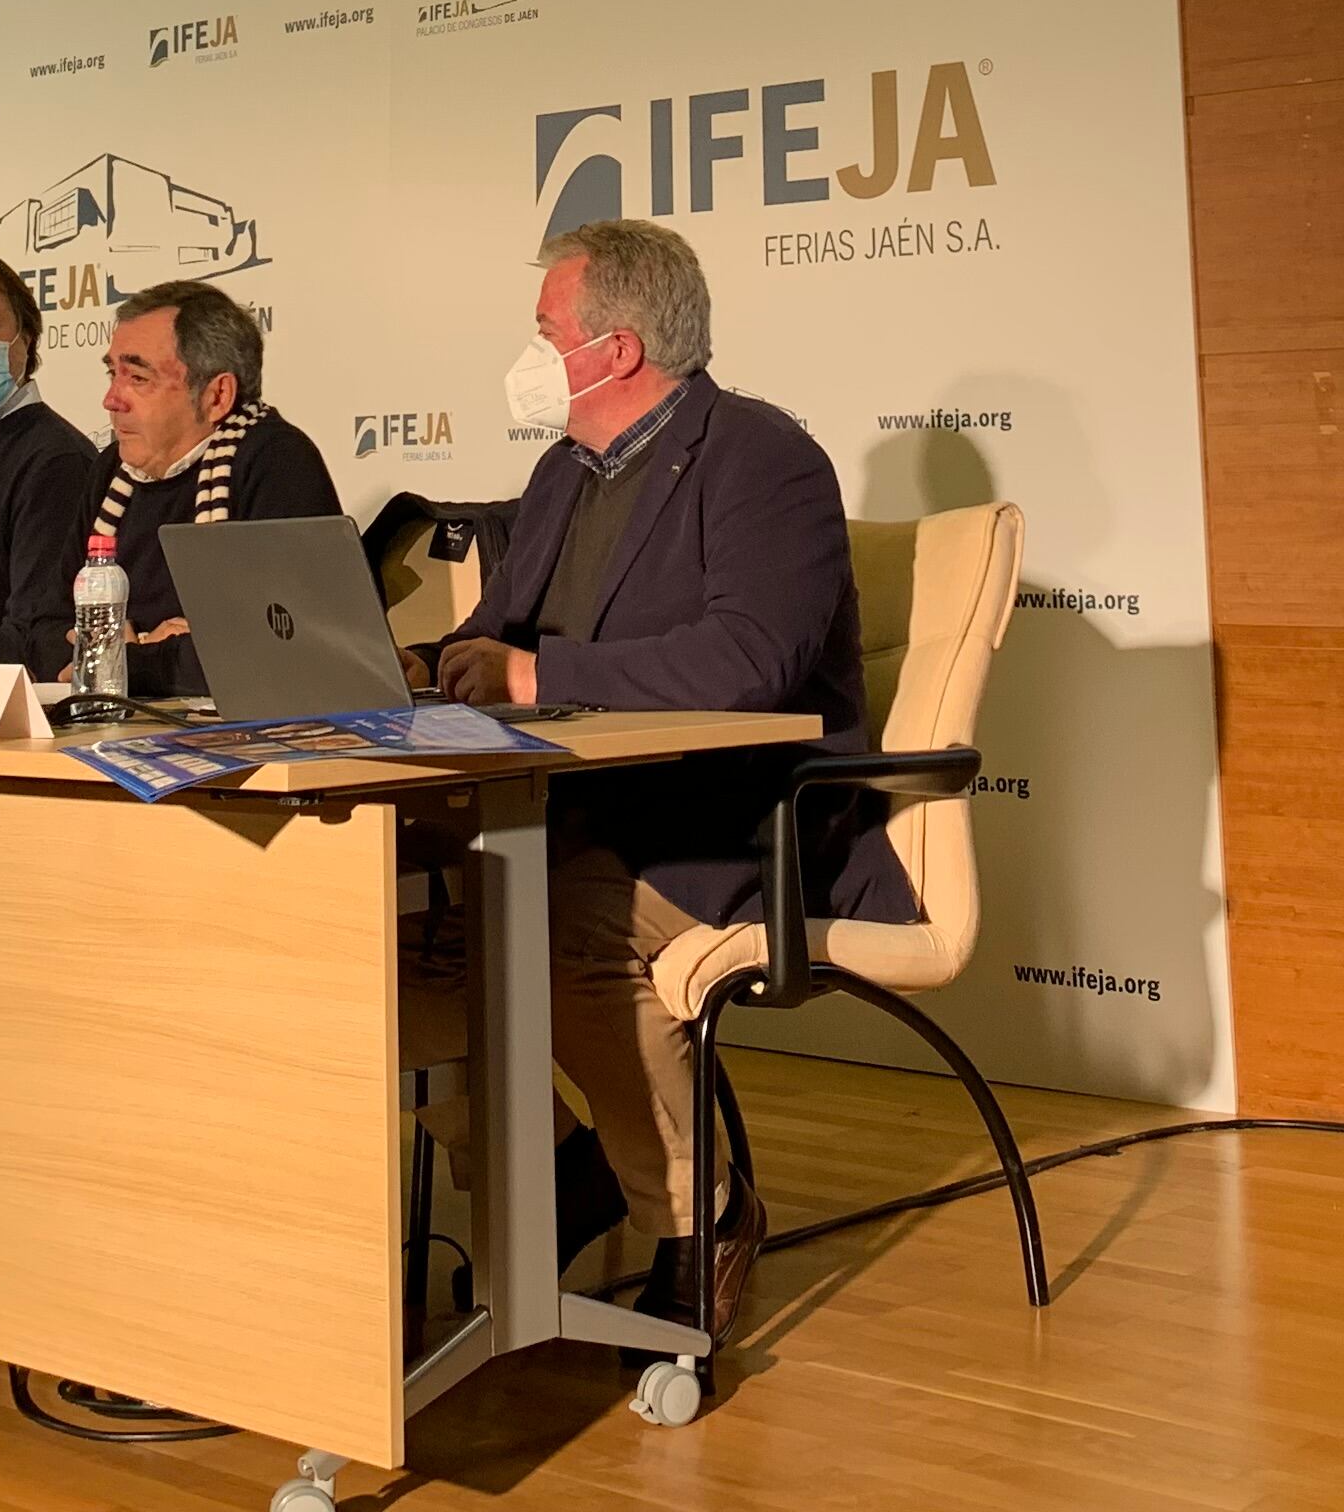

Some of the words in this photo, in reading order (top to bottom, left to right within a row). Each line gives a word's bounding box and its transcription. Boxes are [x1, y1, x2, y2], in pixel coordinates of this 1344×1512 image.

[284, 5, 375, 33] www.ifeja.org
[173, 15, 239, 54] IFEJA
[30, 53, 106, 78] www.ifeja.org
[765, 230, 855, 267] FERIAS
[864, 217, 934, 260] JAÉN
[946, 219, 1001, 254] S.A.
[48, 324, 70, 349] DE
[383, 412, 453, 447] IFEJA
[877, 408, 1012, 433] www.ifeja.org
[1014, 588, 1140, 615] ww.ifeja.org
[1014, 965, 1161, 1002] www.ifeja.org
